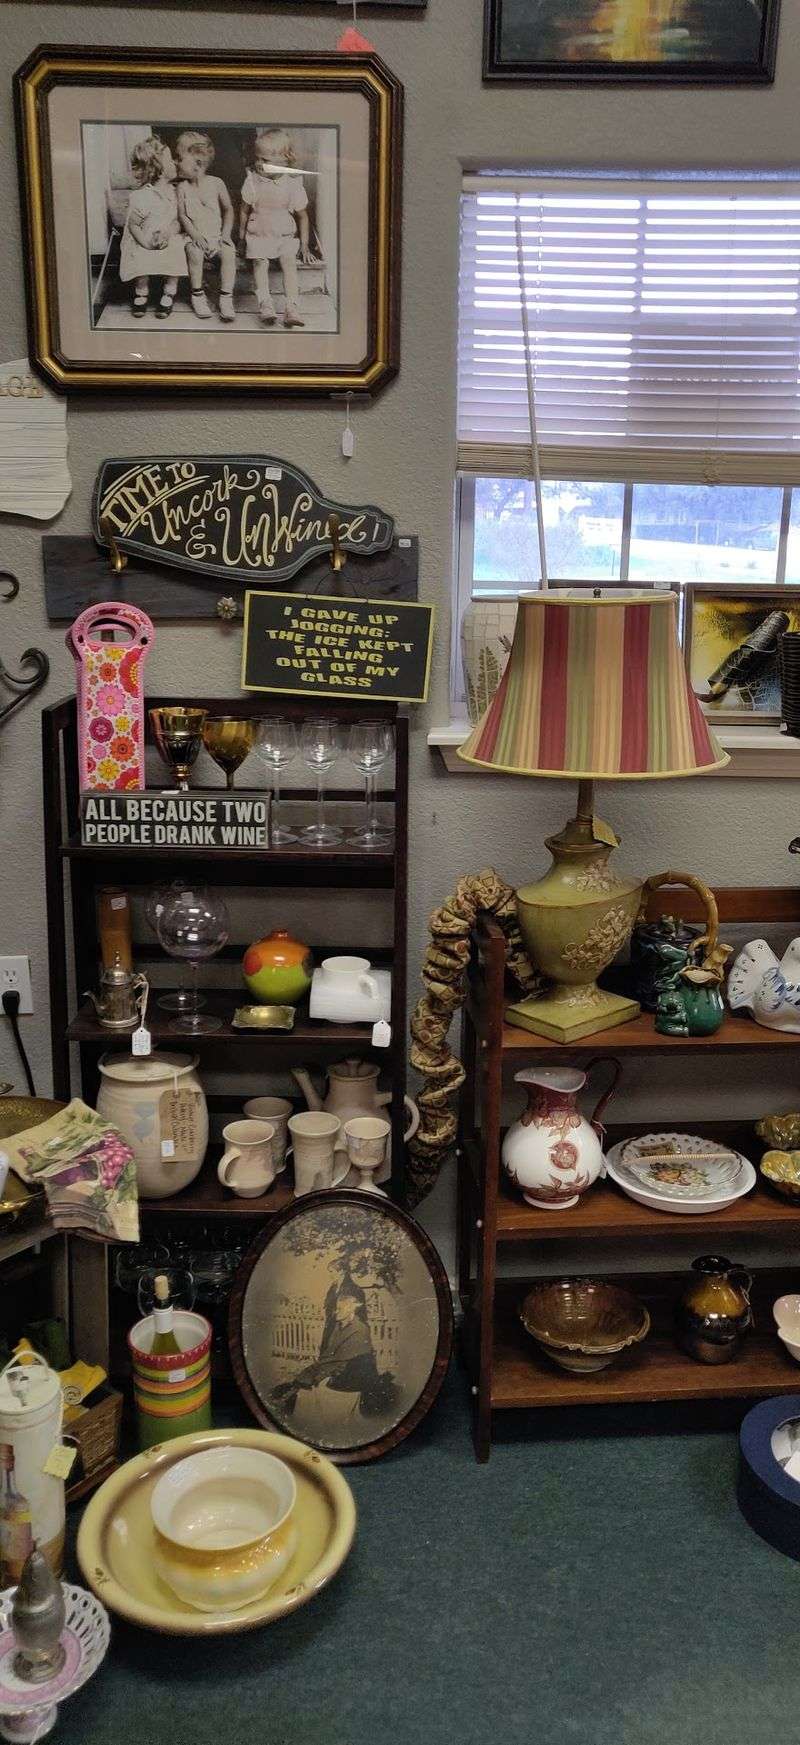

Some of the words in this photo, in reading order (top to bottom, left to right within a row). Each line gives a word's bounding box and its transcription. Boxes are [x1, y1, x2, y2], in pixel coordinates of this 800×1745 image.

[101, 465, 168, 532] TIME
[166, 462, 196, 484] TO
[140, 465, 261, 545] Uncork
[185, 519, 216, 559] &
[284, 606, 292, 616] I
[301, 608, 359, 623] GAVE
[368, 614, 399, 625] UP
[265, 629, 306, 643] THE
[314, 635, 350, 648] ICE
[358, 639, 414, 653] KEPT
[294, 645, 384, 664] FALLING
[276, 657, 322, 669] OUT
[330, 662, 358, 673] OF
[365, 665, 400, 677] MY
[300, 672, 373, 688] GLASS
[85, 799, 122, 821] ALL
[126, 800, 217, 823] BECAUSE
[221, 801, 266, 823] TWO
[86, 824, 151, 843] PEOPLE
[154, 825, 216, 845] DRANK
[221, 826, 266, 846] WINE
